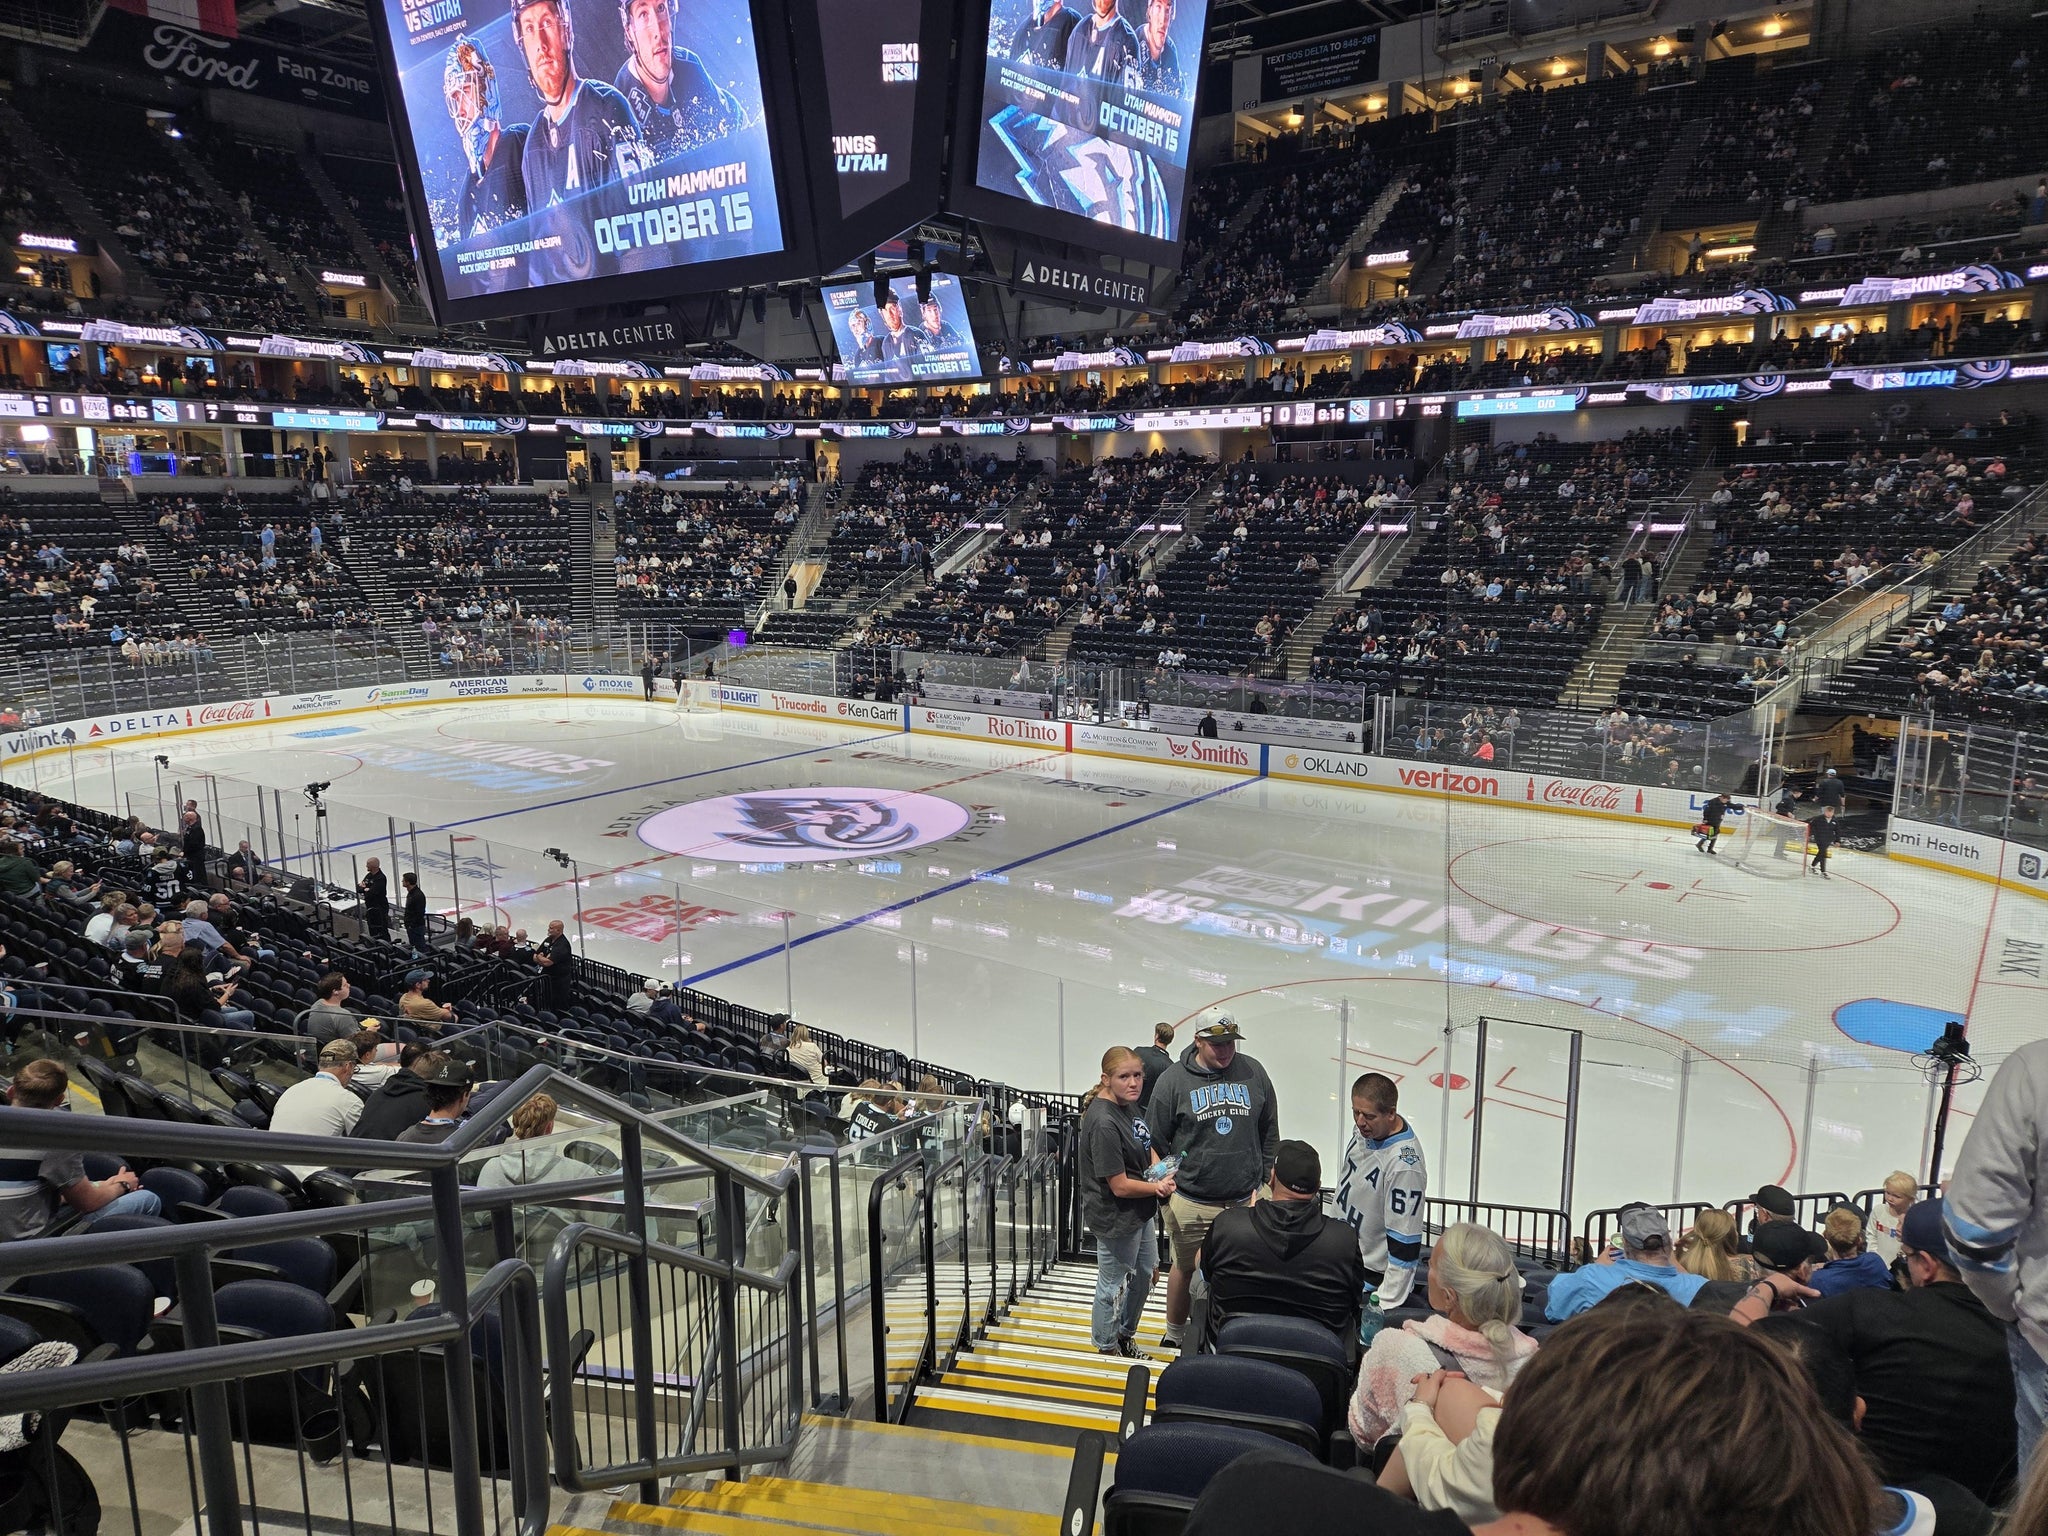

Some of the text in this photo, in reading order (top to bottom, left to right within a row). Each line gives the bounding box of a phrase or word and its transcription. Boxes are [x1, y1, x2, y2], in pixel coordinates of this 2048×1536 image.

[404, 10, 422, 33] VS
[432, 0, 462, 23] UTAH
[143, 25, 261, 90] Ford
[1266, 34, 1377, 65] TEXT SOS DELTA TO 848-261
[1480, 56, 1497, 67] HH
[277, 56, 371, 95] Fan Zone
[882, 63, 895, 82] VS
[1124, 93, 1181, 127] UTAH MAMMOTH
[1100, 101, 1179, 152] OCTOBER 15
[566, 144, 582, 190] A
[837, 154, 888, 172] UTAH
[628, 161, 747, 205] UTAH MAMMOTH
[594, 191, 753, 254] OCTOBER 15
[457, 242, 534, 264] PARTY ON SEATGEEK PLAZA
[1366, 250, 1410, 267] SEATGEEK
[459, 263, 476, 275] PUCK
[475, 261, 490, 273] DROP
[322, 271, 366, 286] SEATGEEK
[1039, 265, 1146, 304] DELTA CENTER
[1910, 273, 1966, 293] KINGS
[1696, 296, 1744, 313] KINGS
[1509, 313, 1551, 329] KINGS
[138, 327, 182, 343] KINGS
[557, 323, 676, 350] DELTA CENTER
[1349, 329, 1385, 343] KINGS
[309, 341, 344, 356] KINGS
[1209, 341, 1241, 354] KINGS
[455, 353, 489, 367] KINGS
[1088, 352, 1116, 364] KINGS
[595, 362, 629, 375] KINGS
[729, 364, 762, 377] KINGS
[912, 361, 959, 375] OCTOBER
[960, 360, 972, 373] 15
[1904, 370, 1957, 387] UTAH
[1691, 384, 1738, 398] UTAH
[4, 403, 17, 412] 14
[60, 398, 76, 415] 0
[113, 405, 148, 418] 8:16
[186, 404, 195, 420] 1
[1378, 402, 1385, 418] 1
[1397, 406, 1405, 416] 7
[1473, 403, 1480, 412] 3
[1496, 401, 1518, 410] 41%
[1537, 399, 1556, 409] 0/0
[209, 411, 217, 420] 7
[288, 416, 294, 424] 3
[309, 417, 330, 426] 41%
[345, 418, 361, 427] 0/0
[1280, 407, 1290, 422] 0
[1317, 408, 1345, 421] 8:16
[464, 420, 496, 431] UTAH
[603, 424, 634, 435] UTAH
[861, 425, 889, 436] UTAH
[980, 423, 1004, 434] UTAH
[1090, 418, 1116, 429] UTAH
[1174, 419, 1189, 427] 59%
[736, 427, 766, 437] UTAH
[450, 678, 507, 689] AMERICAN
[458, 685, 509, 696] EXPRESS
[599, 679, 633, 688] moxie
[380, 686, 429, 698] SameDay
[711, 686, 758, 704] BUD LIGHT
[292, 700, 322, 711] AMERICA
[323, 699, 341, 708] FIRST
[780, 697, 827, 713] Trucordia
[848, 703, 898, 721] Ken Garff
[200, 702, 256, 725] Coca-Cola
[936, 712, 971, 722] CRAIG SWAPP
[110, 714, 179, 733] DELTA
[987, 717, 1057, 742] Rio Tinto
[1092, 734, 1121, 743] MORETON
[1128, 737, 1158, 747] COMPANY
[1191, 740, 1248, 766] Smith's
[1303, 755, 1369, 778] OKLAND
[1398, 767, 1499, 797] verizon
[1543, 779, 1626, 810] Coca-Cola
[1926, 836, 1980, 860] Health
[620, 894, 738, 920] SEAT
[572, 906, 698, 944] GEEK
[1998, 938, 2045, 979] BANK
[1190, 1083, 1251, 1114] UTAH
[855, 1113, 879, 1132] COOLEY
[1197, 1108, 1250, 1122] HOCKEY CLUB
[1365, 1167, 1380, 1190] A
[1392, 1188, 1422, 1216] 67
